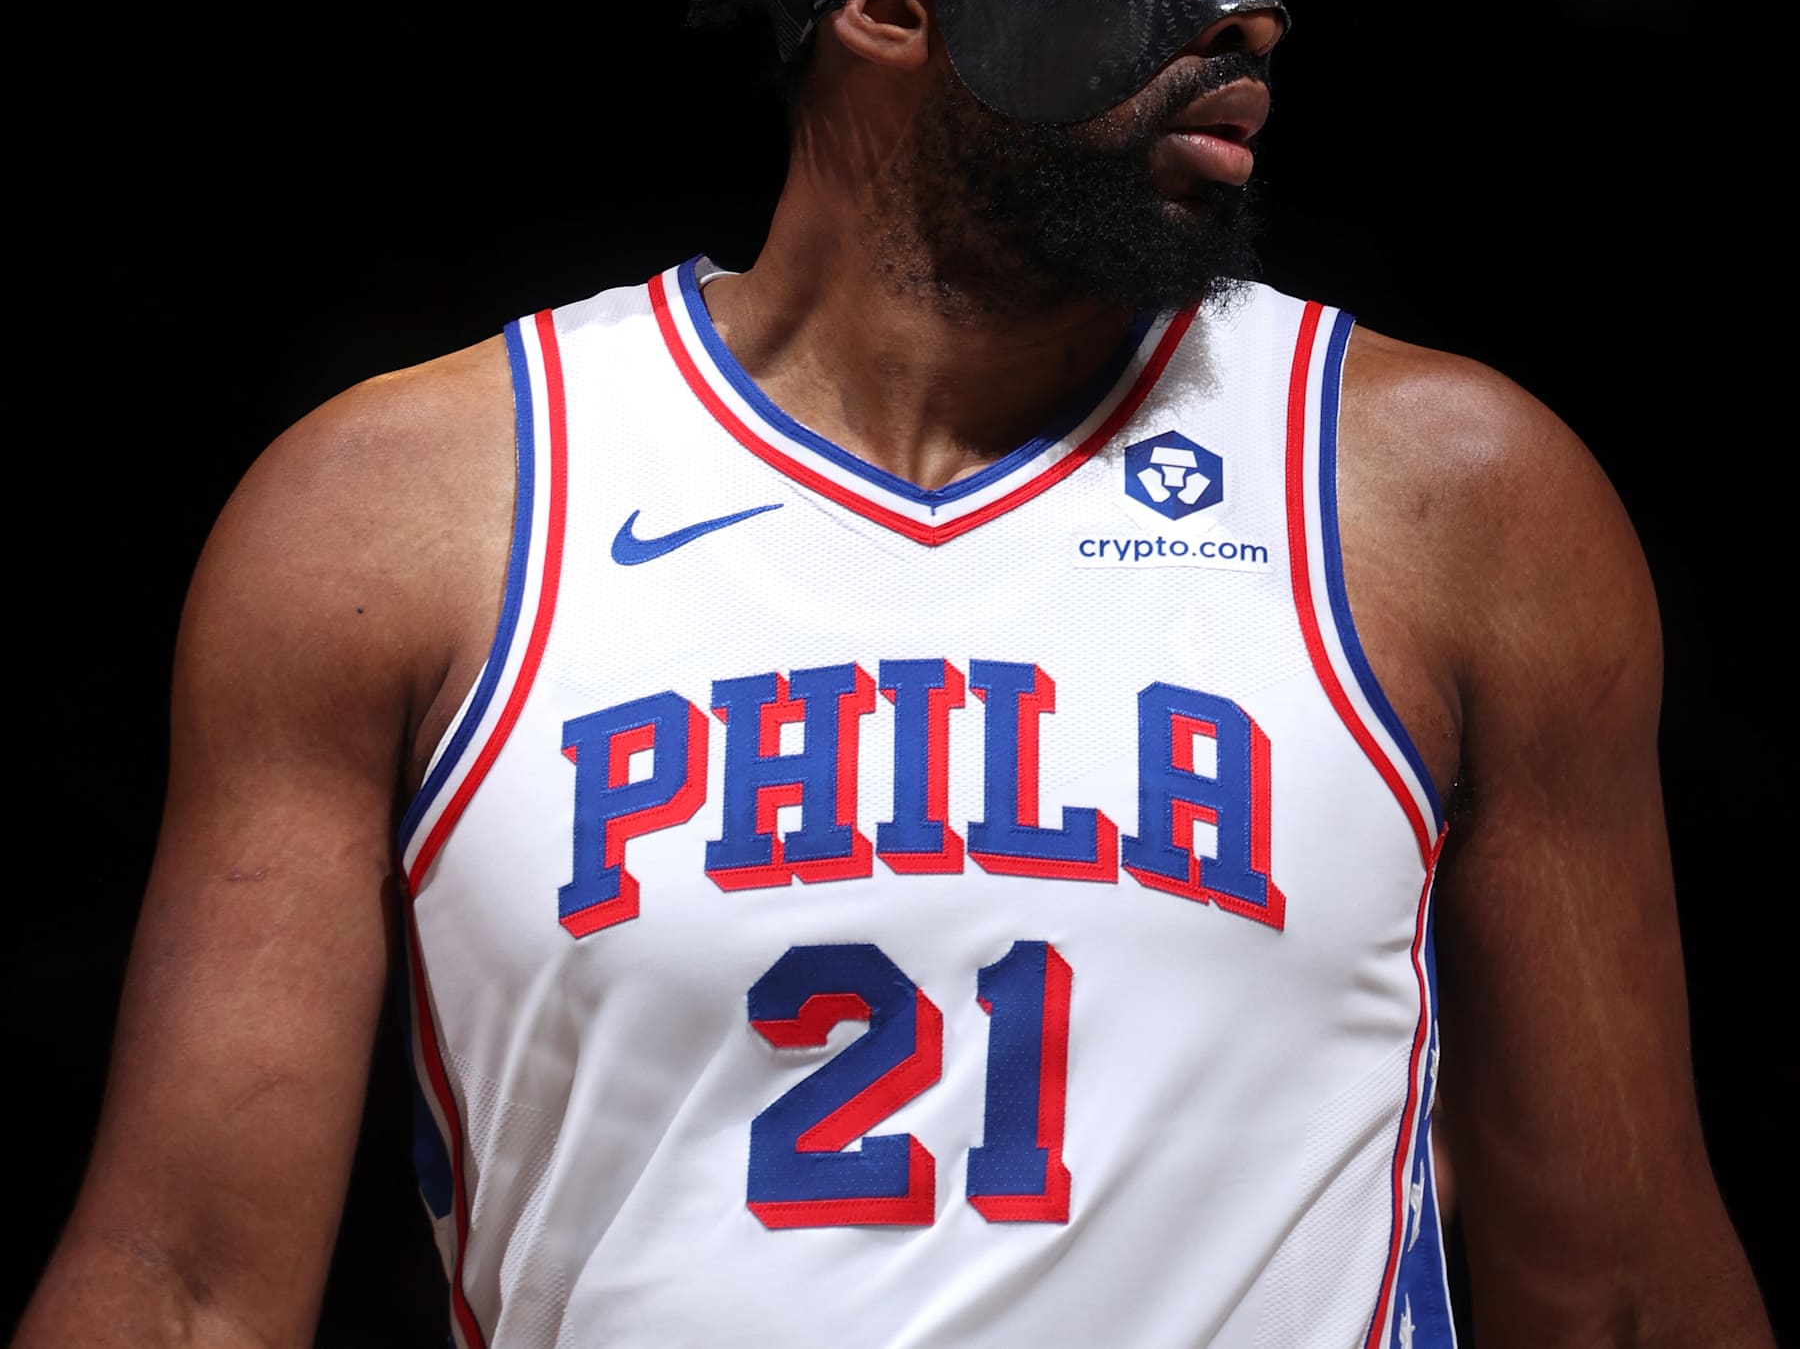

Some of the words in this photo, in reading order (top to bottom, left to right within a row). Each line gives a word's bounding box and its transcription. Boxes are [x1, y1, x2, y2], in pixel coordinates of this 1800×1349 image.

[1079, 536, 1268, 564] crypto.com
[558, 658, 1286, 940] PHILA
[746, 940, 1073, 1230] 21
